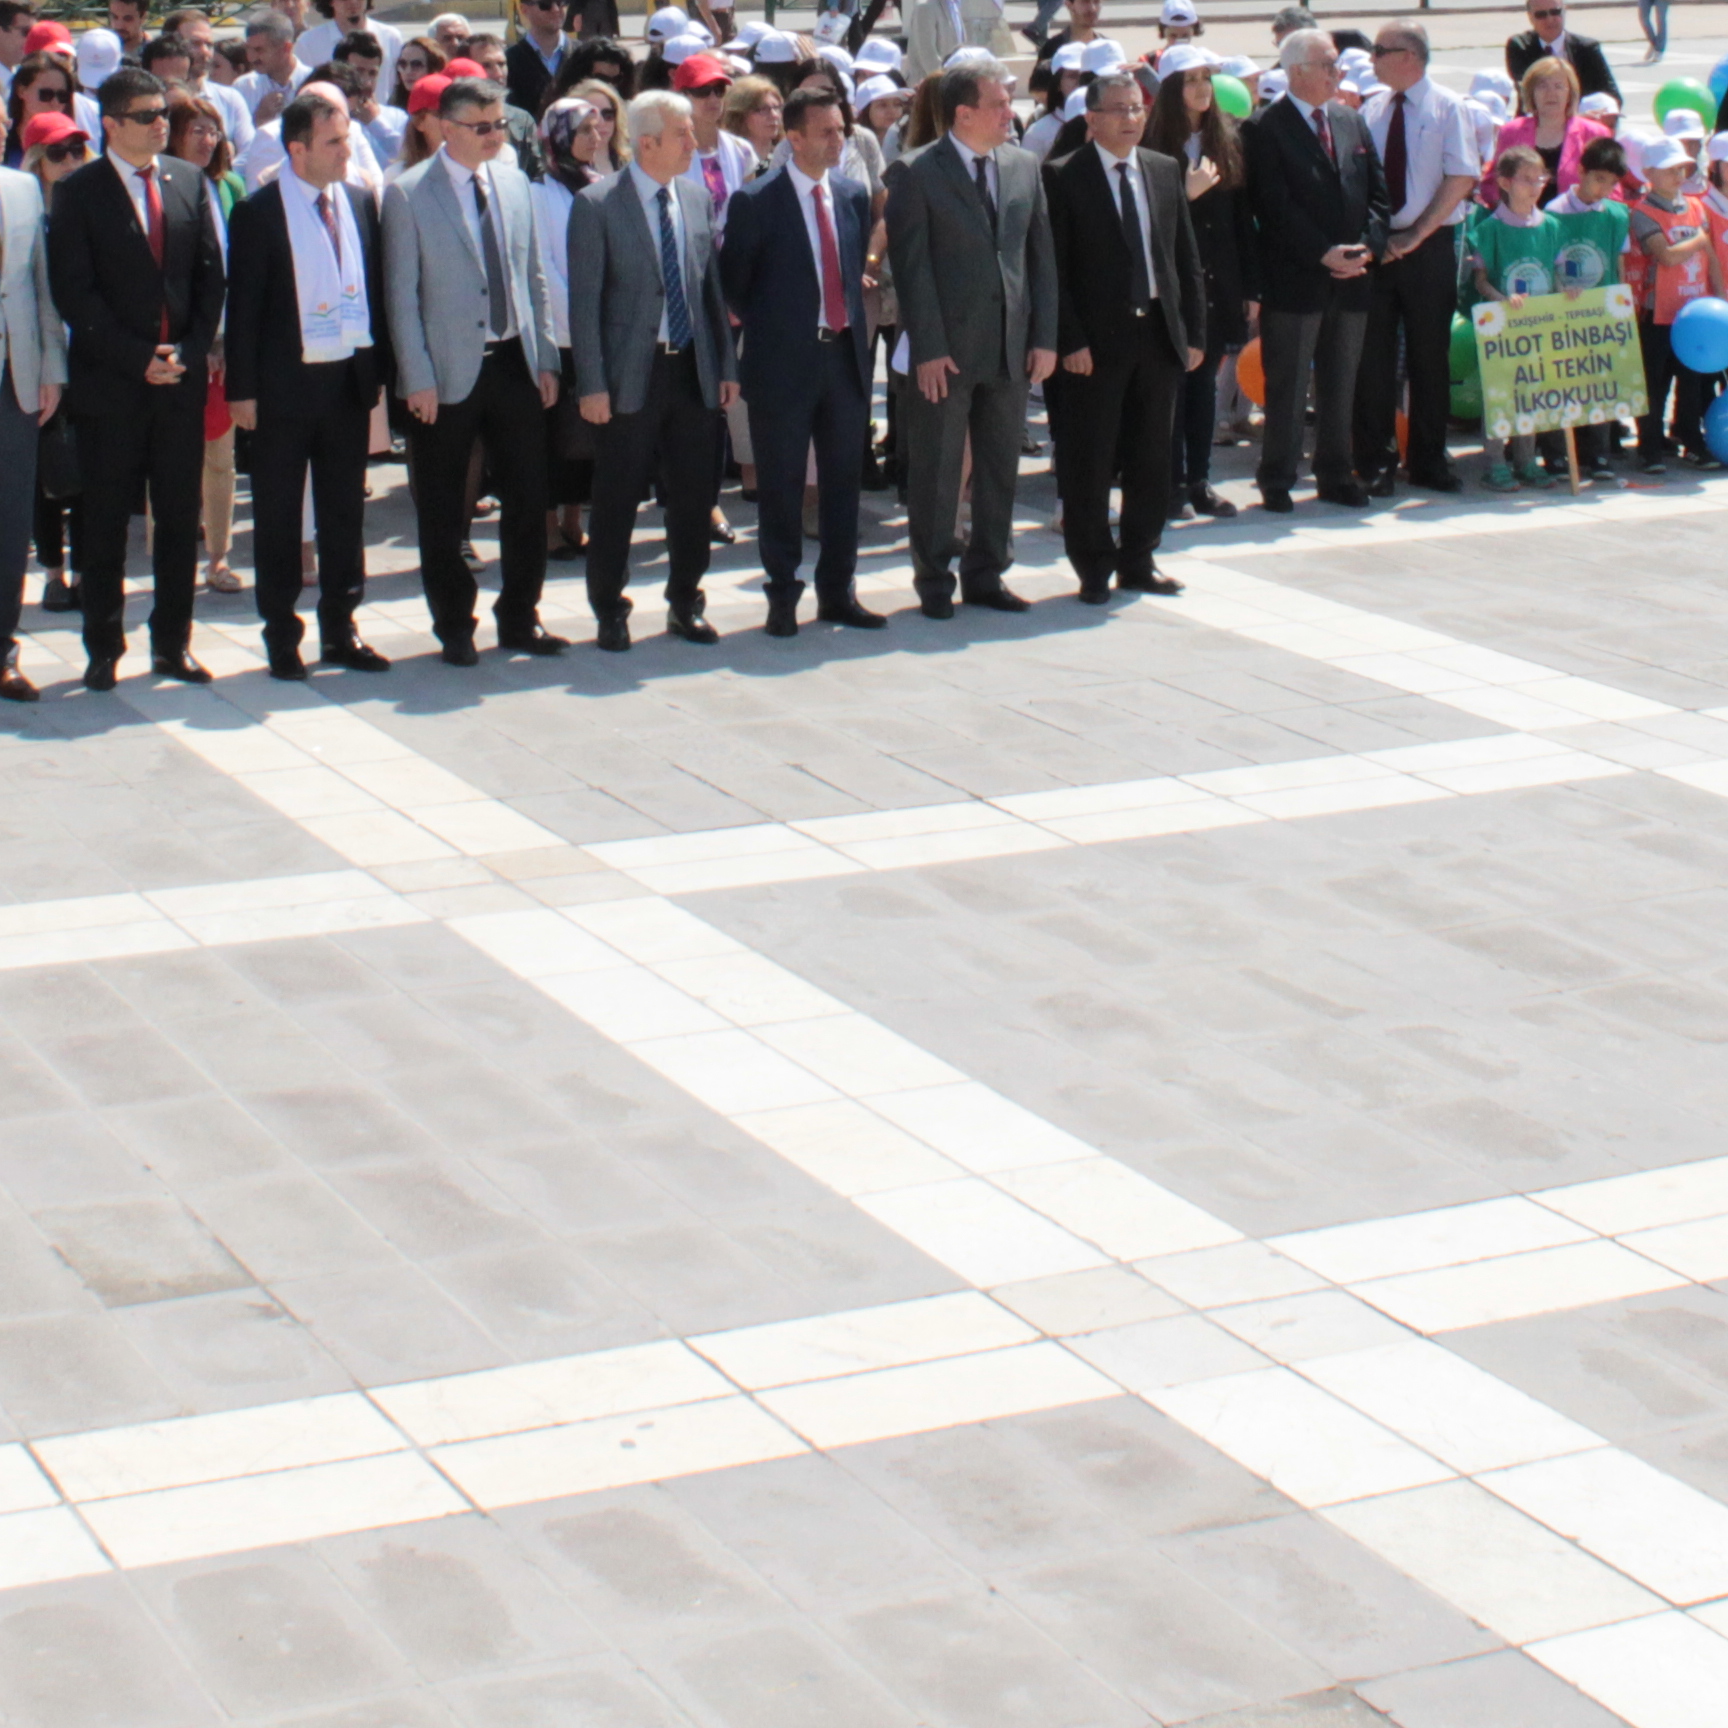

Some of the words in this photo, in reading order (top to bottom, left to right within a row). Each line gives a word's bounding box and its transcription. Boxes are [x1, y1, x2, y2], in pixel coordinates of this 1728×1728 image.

[1508, 311, 1555, 328] ESKİŞEHİR
[1564, 306, 1606, 321] TEPEBAŞI
[1483, 333, 1543, 360] PİLOT
[1550, 320, 1634, 352] BİNBAŞI
[1513, 357, 1546, 386] ALİ
[1552, 349, 1613, 380] TEKİN
[1513, 381, 1618, 414] İLKOKULU
